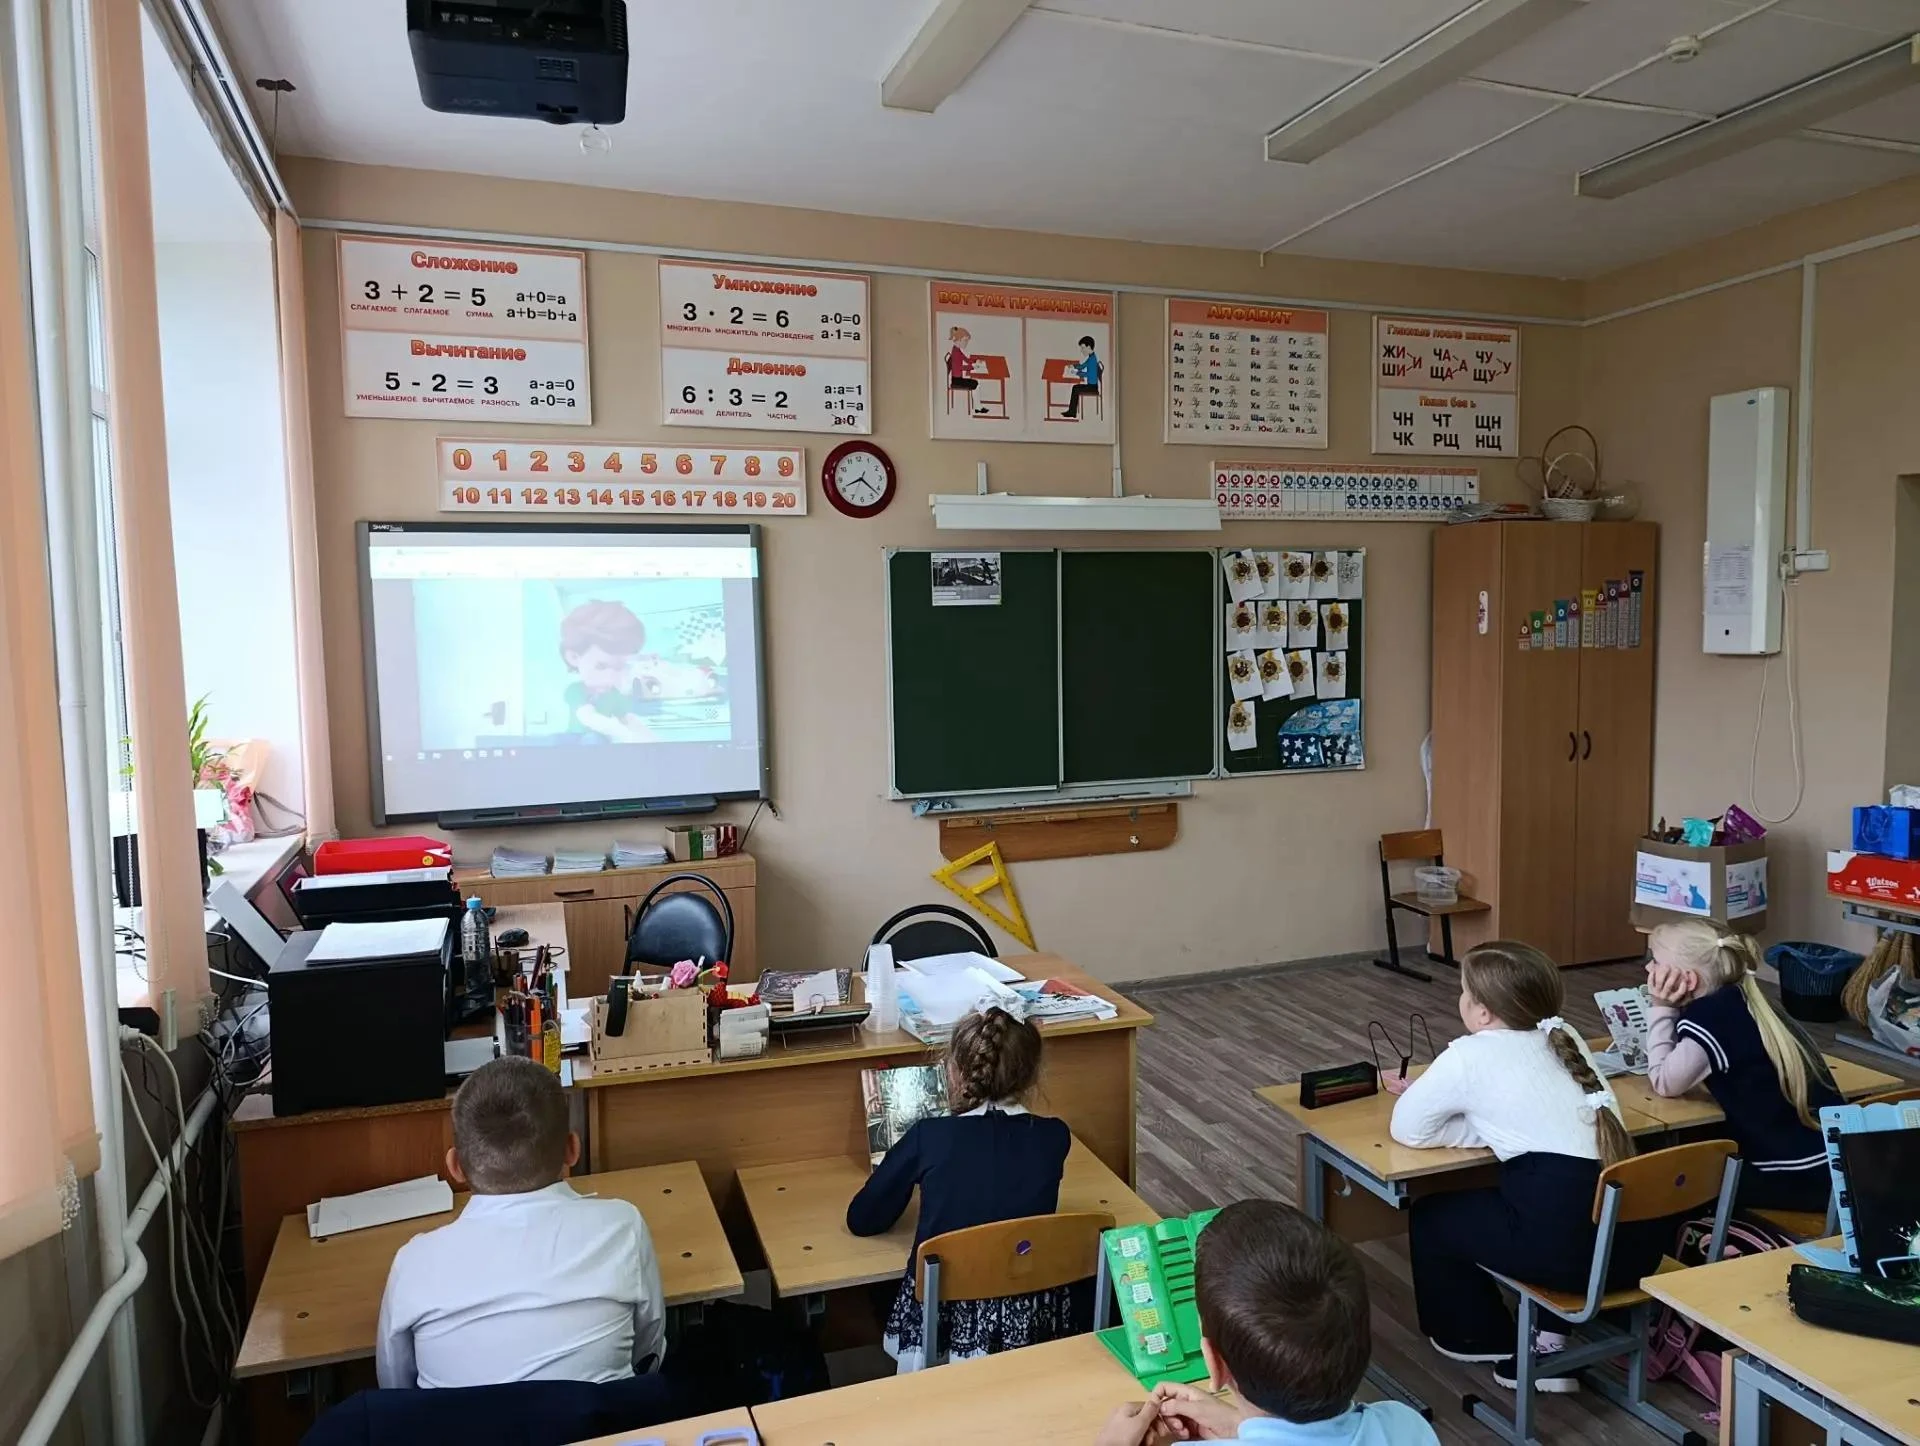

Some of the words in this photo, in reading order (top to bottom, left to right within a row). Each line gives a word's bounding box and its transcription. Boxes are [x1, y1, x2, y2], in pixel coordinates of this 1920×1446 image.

[411, 251, 518, 275] Сложение
[364, 281, 380, 300] 3
[391, 284, 407, 300] +
[418, 284, 434, 303] 2
[444, 291, 461, 300] =
[471, 288, 486, 307] 5
[712, 274, 818, 297] Умножение
[350, 303, 397, 313] СЛАГАЕМОЕ
[404, 306, 449, 316] СЛАГАЕМОЕ
[466, 310, 493, 318] СУММА
[939, 291, 969, 305] ВОТ
[975, 294, 1005, 308] ТАК
[1009, 297, 1108, 316] ПРАВИЛЬНО!
[683, 303, 697, 321] 3
[730, 306, 743, 325] 2
[752, 313, 767, 321] =
[775, 310, 789, 328] 6
[1207, 305, 1293, 324] АЛФАВИТ
[667, 324, 711, 333] МНОЖИТЕЛЬ
[715, 327, 759, 337] МНОЖИТЕЛЬ
[761, 331, 814, 341] ПРОИЗВЕДЕНИЕ
[411, 340, 526, 361] Вычитание
[1383, 345, 1406, 358] ЖИ
[1433, 348, 1451, 361] ЧА
[1476, 351, 1493, 364] ЧУ
[726, 358, 806, 377] Деление
[1382, 363, 1406, 376] ШИ
[1413, 357, 1422, 369] И
[1459, 360, 1468, 372] А
[1503, 362, 1512, 374] У
[1430, 366, 1453, 381] ЩА
[1473, 369, 1496, 384] ЩУ
[385, 372, 400, 391] 5
[431, 374, 447, 392] 2
[457, 380, 473, 389] =
[483, 377, 499, 395] 3
[356, 394, 417, 403] УМЕНЬШАЕМОЕ
[422, 397, 475, 405] ВЫЧИТАЕМОЕ
[481, 399, 520, 407] РАЗНОСТЬ
[682, 386, 696, 404] 6
[729, 388, 743, 406] 3
[752, 394, 766, 403] =
[774, 391, 788, 408] 2
[669, 408, 704, 416] ДЕЛИМОЕ
[716, 410, 752, 418] ДЕЛИТЕЛЬ
[767, 412, 797, 420] ЧАСТНОЕ
[1393, 412, 1414, 426] ЧН
[1432, 414, 1452, 427] ЧТ
[1475, 415, 1501, 431] ЩН
[1393, 432, 1414, 446] ЧК
[1433, 433, 1459, 450] РЩ
[1476, 435, 1502, 451] НЩ
[453, 448, 472, 470] 0
[492, 449, 507, 471] 1
[530, 450, 549, 472] 2
[568, 451, 585, 473] 3
[603, 452, 622, 473] 4
[640, 453, 658, 474] 5
[675, 454, 693, 474] 6
[710, 455, 727, 475] 7
[744, 456, 761, 476] 8
[778, 456, 794, 477] 9
[452, 487, 480, 504] 10
[487, 487, 512, 504] 11
[521, 488, 548, 505] 12
[554, 488, 581, 505] 13
[587, 489, 613, 506] 14
[619, 489, 645, 506] 15
[651, 490, 676, 506] 16
[682, 490, 707, 507] 17
[713, 491, 737, 507] 18
[743, 491, 767, 508] 19
[772, 492, 796, 508] 20
[1865, 876, 1899, 888] Watson
